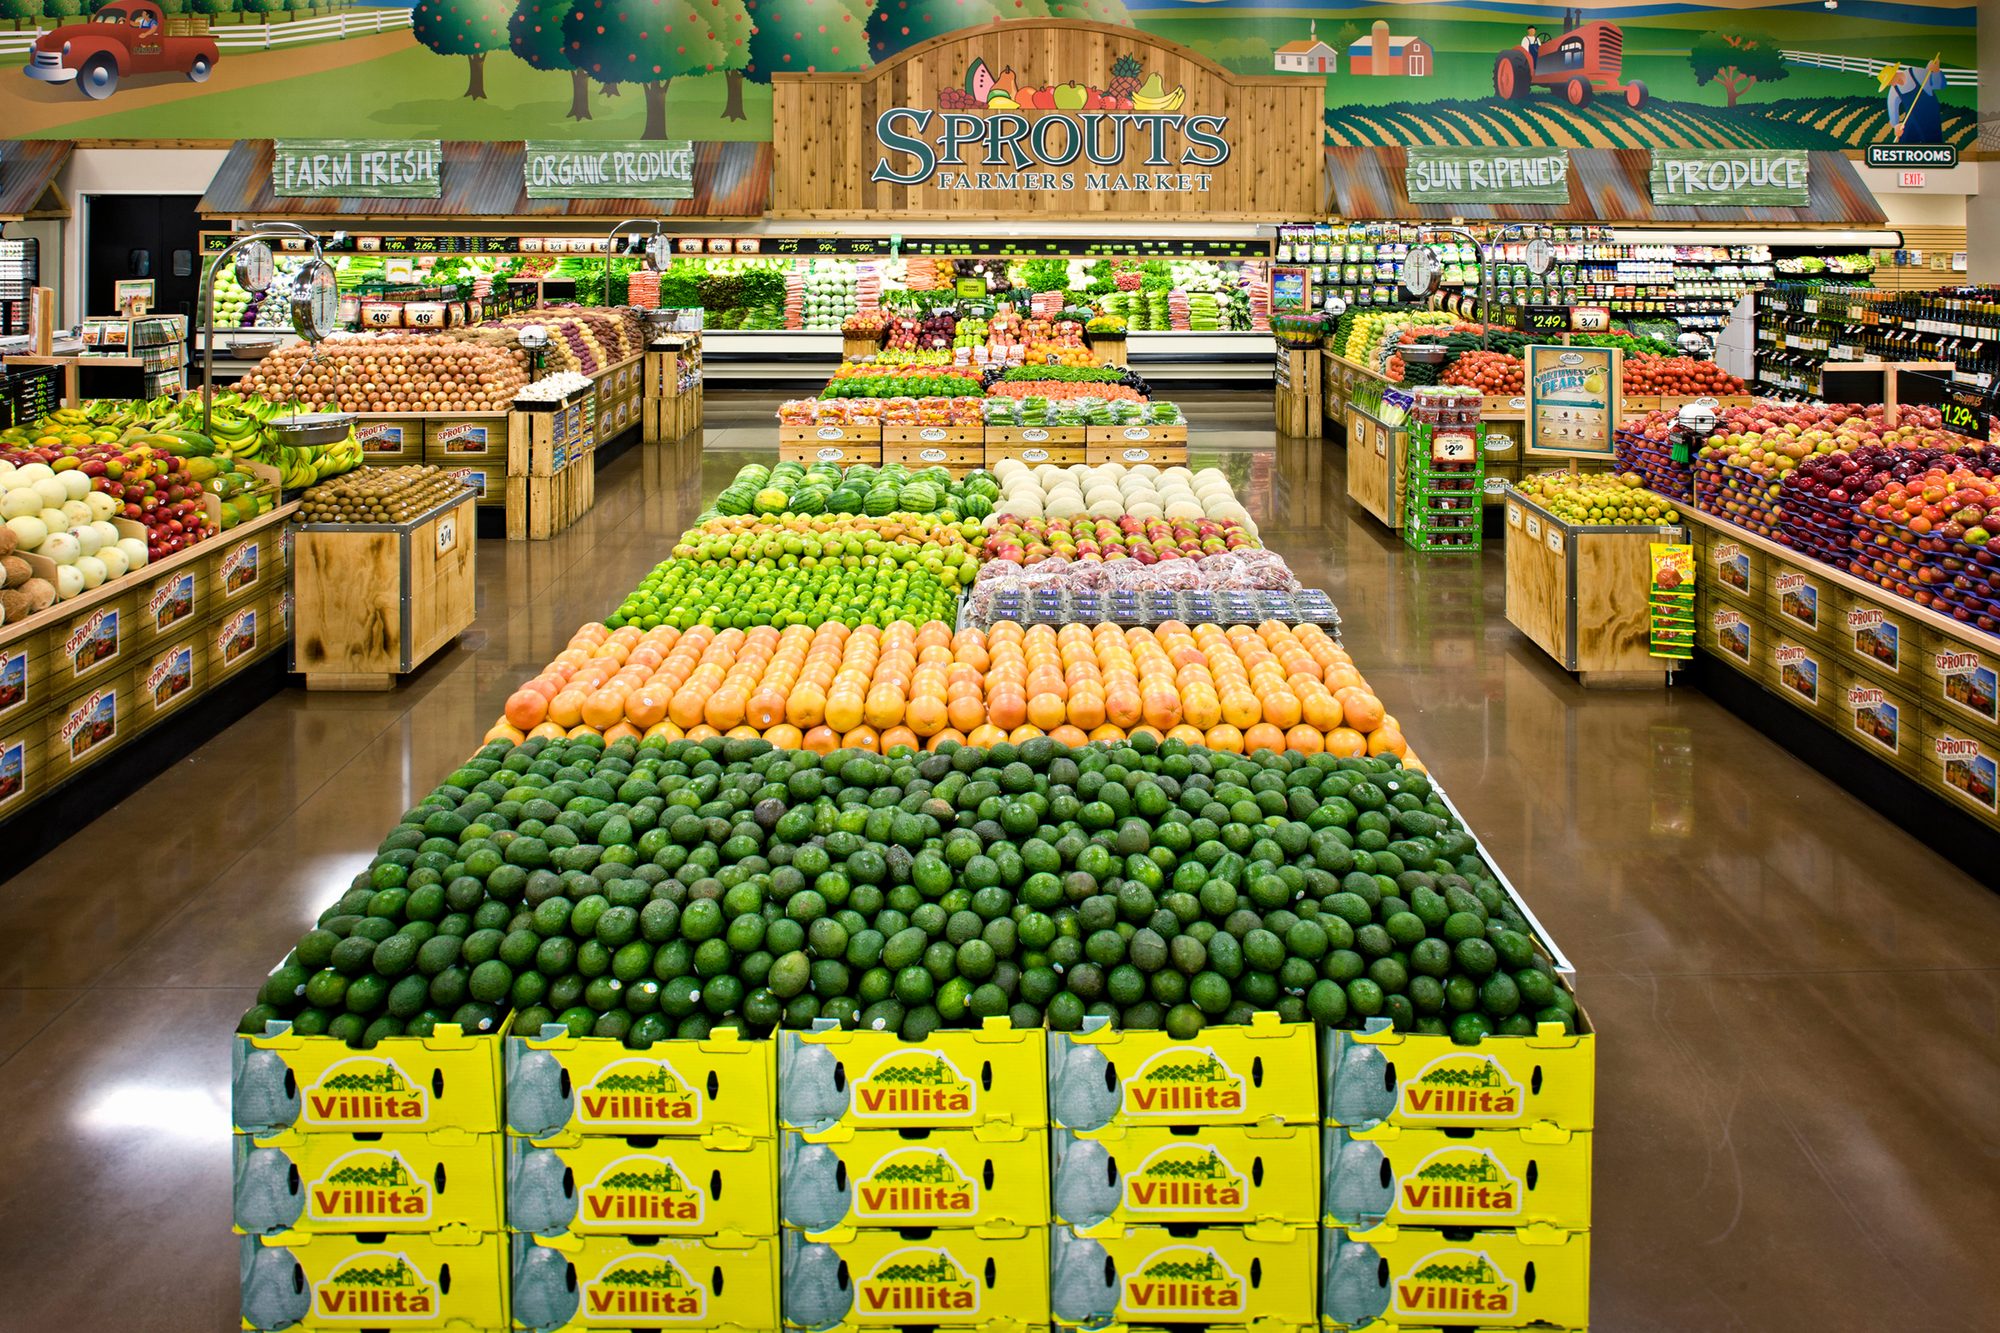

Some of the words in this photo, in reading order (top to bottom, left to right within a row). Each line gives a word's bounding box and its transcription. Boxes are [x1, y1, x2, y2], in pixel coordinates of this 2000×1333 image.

[871, 107, 1230, 184] SPROUTS
[1873, 149, 1951, 162] RESTROOMS
[284, 152, 352, 190] FARM
[361, 149, 433, 186] FRESH
[532, 152, 609, 187] ORGANIC
[613, 150, 691, 184] PRODUCE
[1416, 160, 1462, 192] SUN
[1468, 157, 1565, 191] RIPENED
[1664, 157, 1802, 194] PRODUCE
[1904, 173, 1920, 185] EXIT
[938, 172, 1075, 190] FARMERS
[1085, 173, 1212, 191] MARKET
[1533, 315, 1561, 328] $2.49
[1541, 375, 1586, 397] PEARS
[354, 423, 388, 440] SPROUTS
[438, 423, 473, 440] SPROUTS
[220, 541, 248, 578] SPROUTS
[1714, 544, 1739, 559] SPROUTS
[150, 572, 182, 613] SPROUTS
[1776, 574, 1805, 589] SPROUTS
[1714, 612, 1740, 626] SPROUTS
[1849, 609, 1883, 625] SPROUTS
[66, 608, 104, 655] SPROUTS
[218, 610, 246, 648] SPROUTS
[1776, 647, 1805, 661] SPROUTS
[1936, 653, 1978, 669] SPROUTS
[147, 647, 179, 690] SPROUTS
[1849, 688, 1883, 703] SPROUTS
[62, 691, 101, 740] SPROUTS
[1936, 739, 1978, 756] SPROUTS
[313, 1096, 422, 1119] Villita
[585, 1097, 692, 1119] Villita
[863, 1089, 969, 1112] Villita
[1134, 1087, 1241, 1110] Villita
[1408, 1090, 1515, 1113] Villita
[317, 1191, 424, 1214] Villita
[864, 1188, 970, 1211] Villita
[1134, 1183, 1240, 1206] Villita
[1405, 1186, 1513, 1210] Villita
[590, 1196, 697, 1220] Villita
[322, 1291, 430, 1314] Villita
[591, 1291, 698, 1315] Villita
[866, 1287, 973, 1310] Villita
[1131, 1284, 1238, 1307] Villita
[1401, 1287, 1508, 1311] Villita
